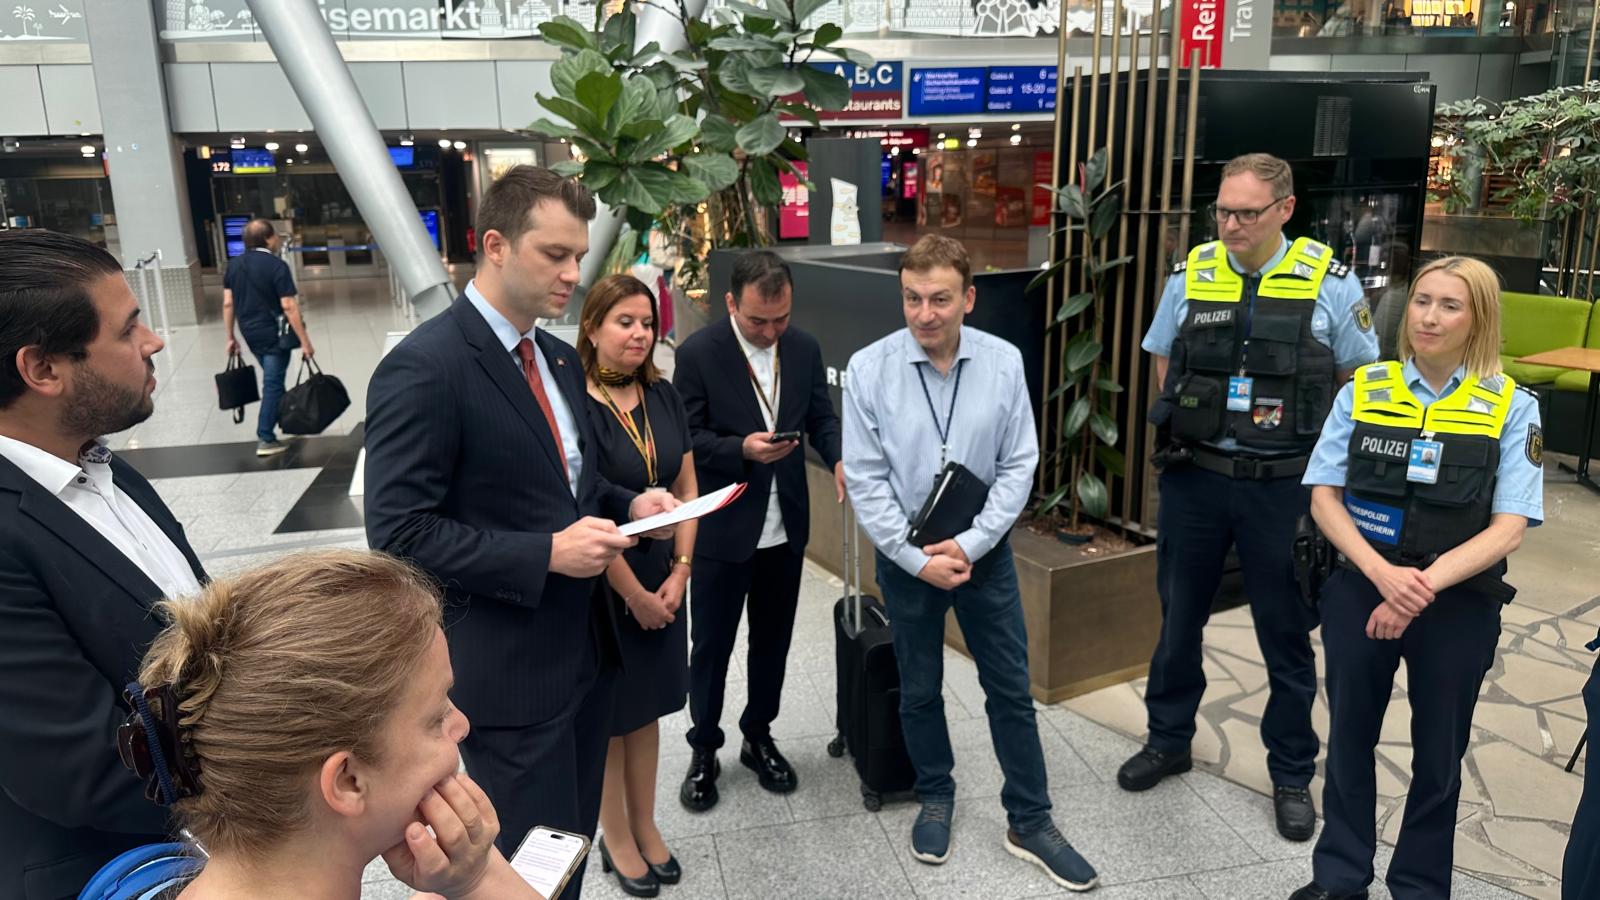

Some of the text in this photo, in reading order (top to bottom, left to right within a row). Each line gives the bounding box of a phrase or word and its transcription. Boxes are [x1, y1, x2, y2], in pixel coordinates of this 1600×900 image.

[1192, 0, 1216, 40] Rei
[212, 162, 230, 172] 172
[1194, 310, 1231, 325] POLIZEI
[1361, 436, 1408, 458] POLIZEI
